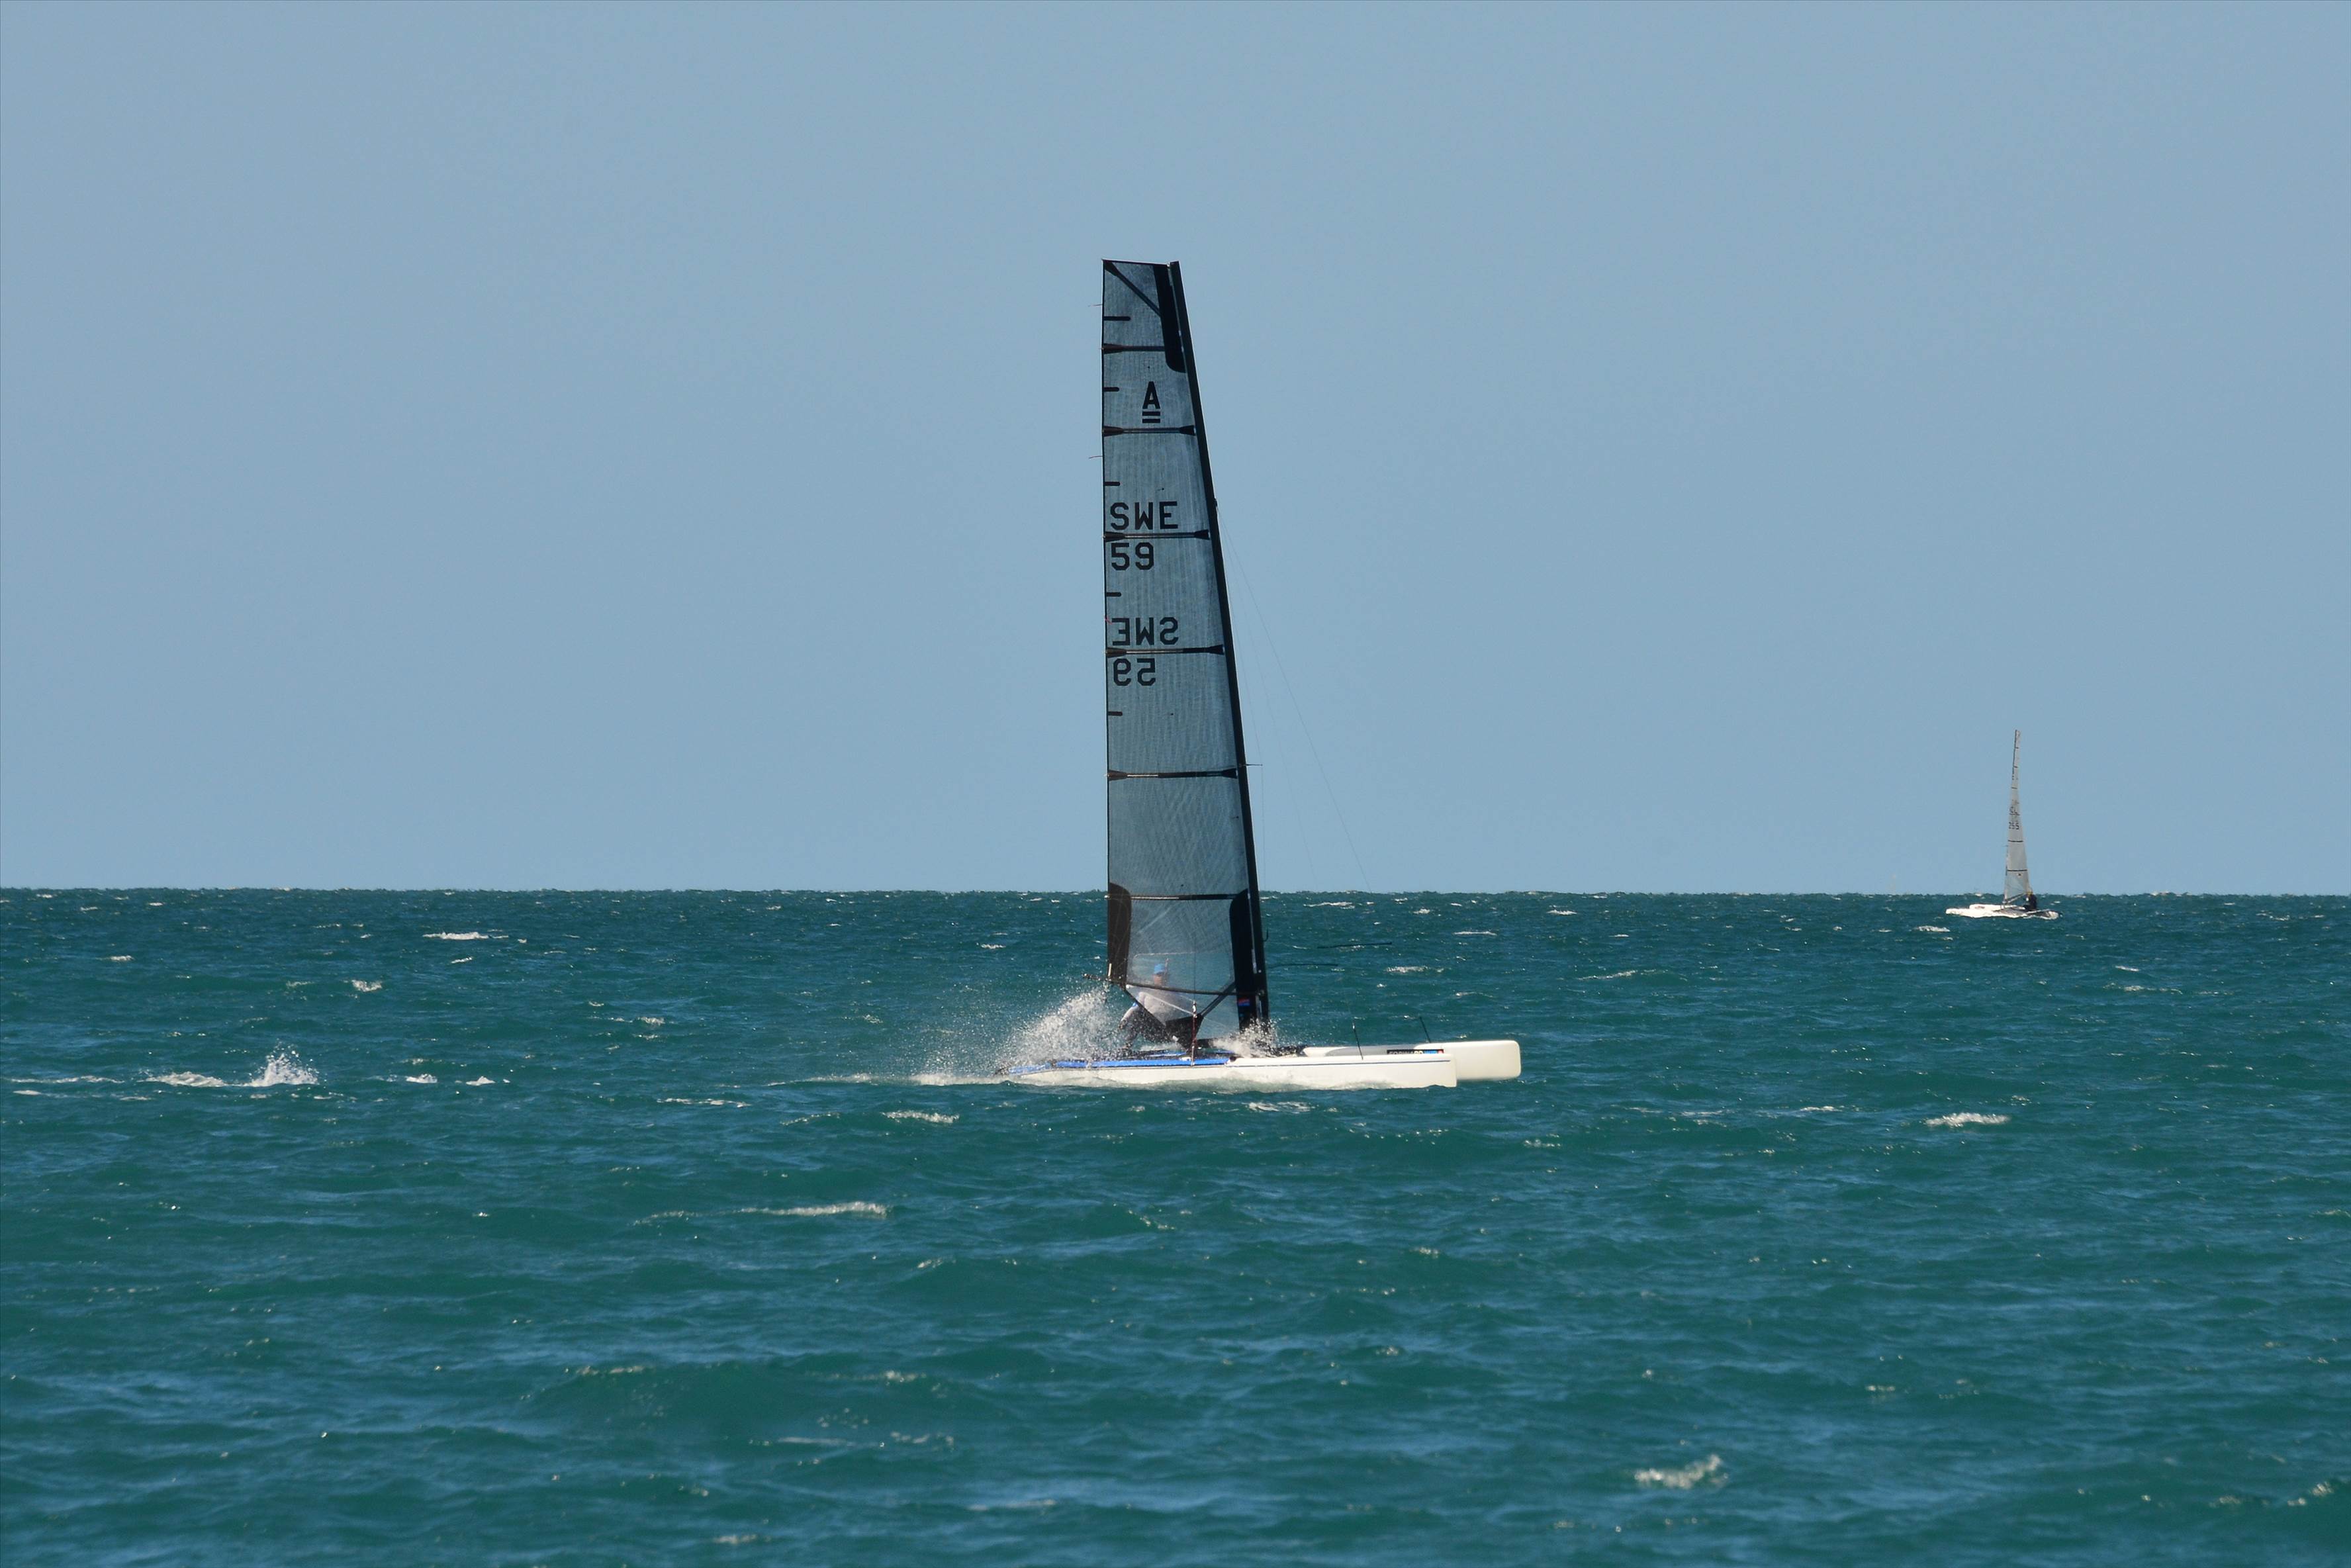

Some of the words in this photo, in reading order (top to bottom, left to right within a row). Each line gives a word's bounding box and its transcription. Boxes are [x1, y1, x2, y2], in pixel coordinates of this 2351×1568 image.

[1142, 381, 1161, 410] A
[1110, 501, 1179, 530] SWE
[1111, 542, 1154, 571] 59
